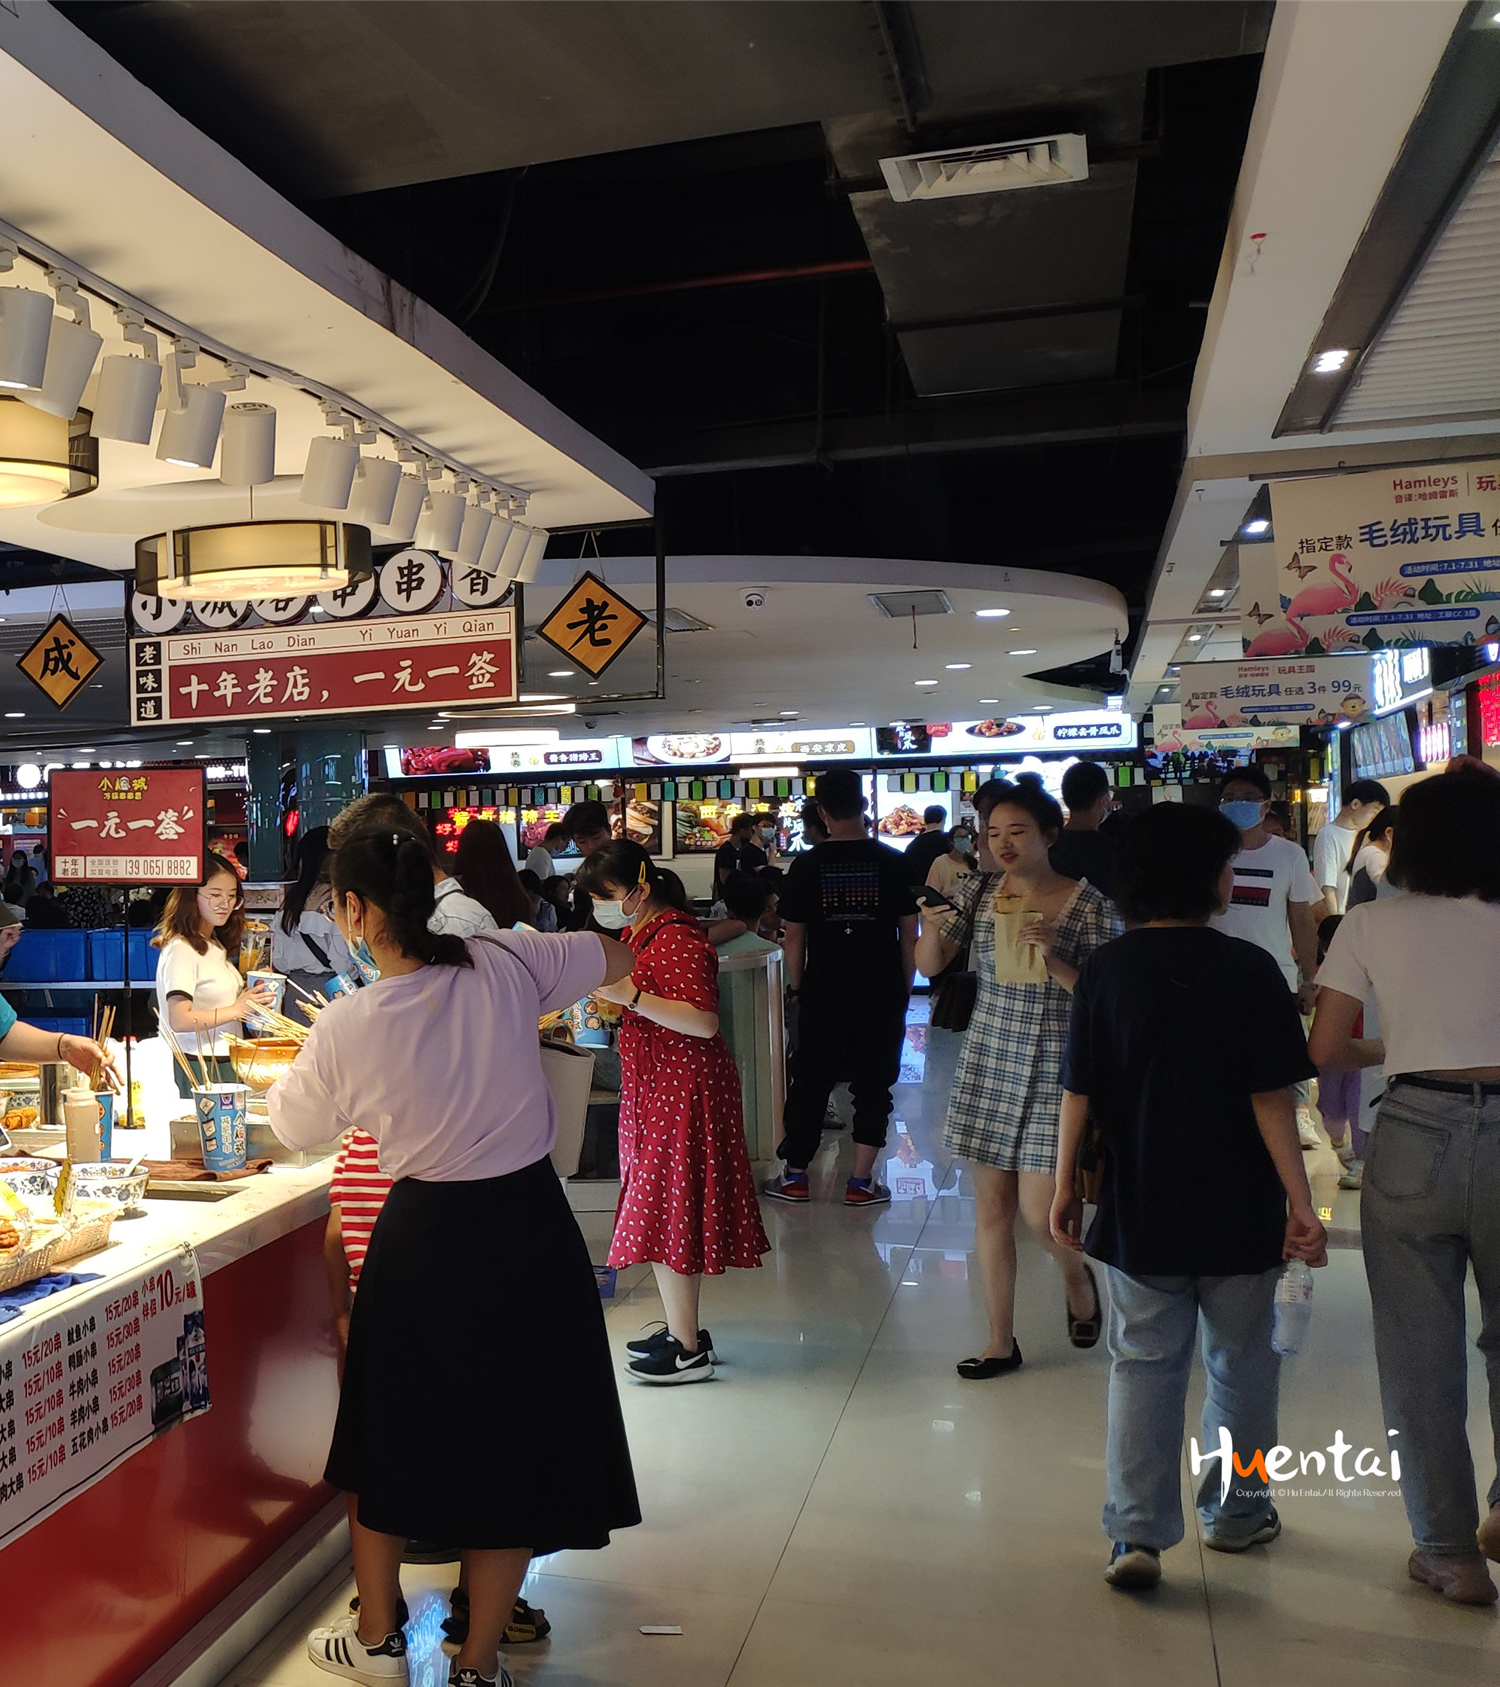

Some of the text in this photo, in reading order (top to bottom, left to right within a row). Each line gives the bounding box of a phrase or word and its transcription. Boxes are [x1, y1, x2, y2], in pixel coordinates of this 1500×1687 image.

[1393, 475, 1458, 492] Hamleys
[1477, 475, 1500, 492] 玩
[1299, 534, 1353, 554] 指定款
[1358, 512, 1486, 548] 毛绒玩具
[183, 620, 495, 656] Shi Nan Lao Dian Yi Yuan Yi Qian
[567, 598, 619, 650] 老
[40, 636, 82, 681] 成
[1220, 684, 1281, 699] 毛绒玩具
[70, 808, 186, 841] 一元一签
[124, 859, 192, 876] 139 0651 8882
[21, 1331, 62, 1370] 15元/20串
[104, 1289, 139, 1323] 15元/20串
[23, 1360, 63, 1399] 15元/10串
[106, 1316, 141, 1350] 15元/30串
[24, 1388, 64, 1427] 15元/10串
[68, 1368, 99, 1402] 牛肉小串
[107, 1342, 141, 1377] 15元/20串
[25, 1416, 65, 1455] 15元/10串
[69, 1395, 100, 1430] 羊肉小串
[109, 1369, 142, 1404] 15元/30串
[27, 1444, 66, 1485] 15元/10串
[70, 1416, 109, 1457] 五花肉小串
[110, 1394, 143, 1429] 15元/20串
